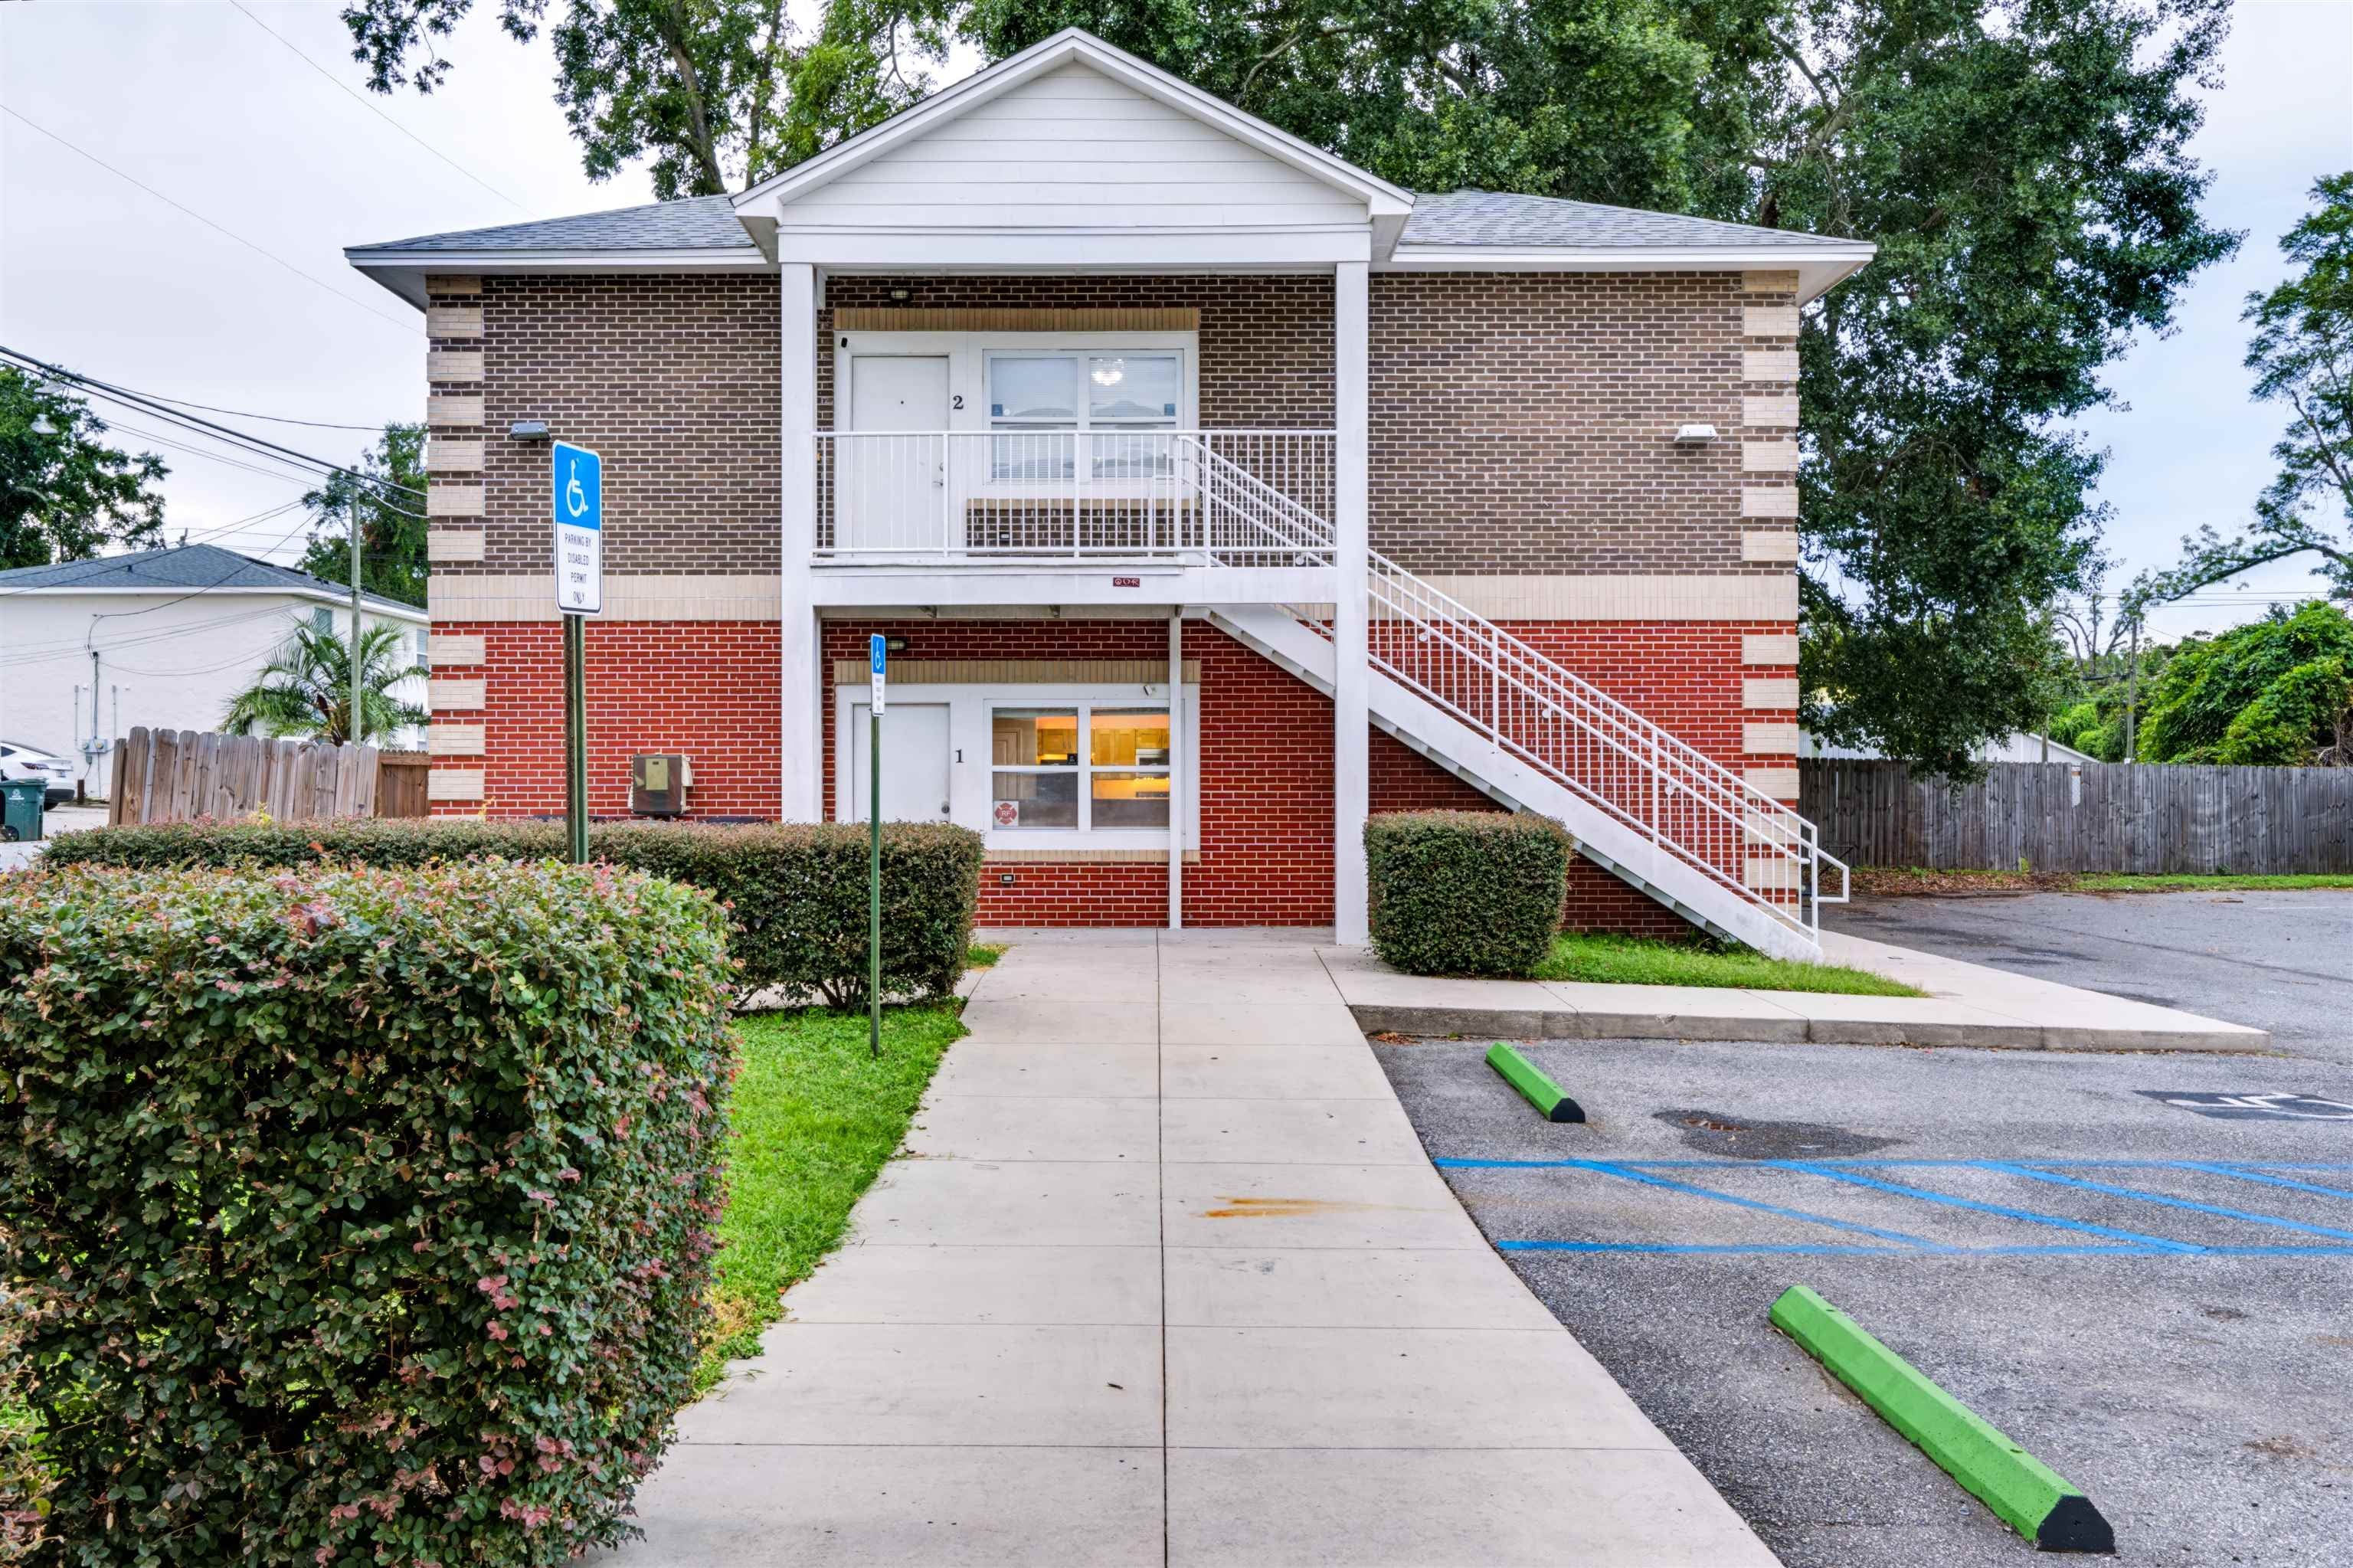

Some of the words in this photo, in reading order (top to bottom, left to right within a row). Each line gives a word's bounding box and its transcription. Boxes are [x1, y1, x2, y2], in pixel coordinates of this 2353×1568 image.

[953, 395, 964, 410] 2
[565, 532, 584, 546] PARKING
[585, 536, 591, 547] BY
[568, 552, 589, 565] DISABLED
[571, 571, 587, 583] PERMIT
[955, 748, 964, 763] 1
